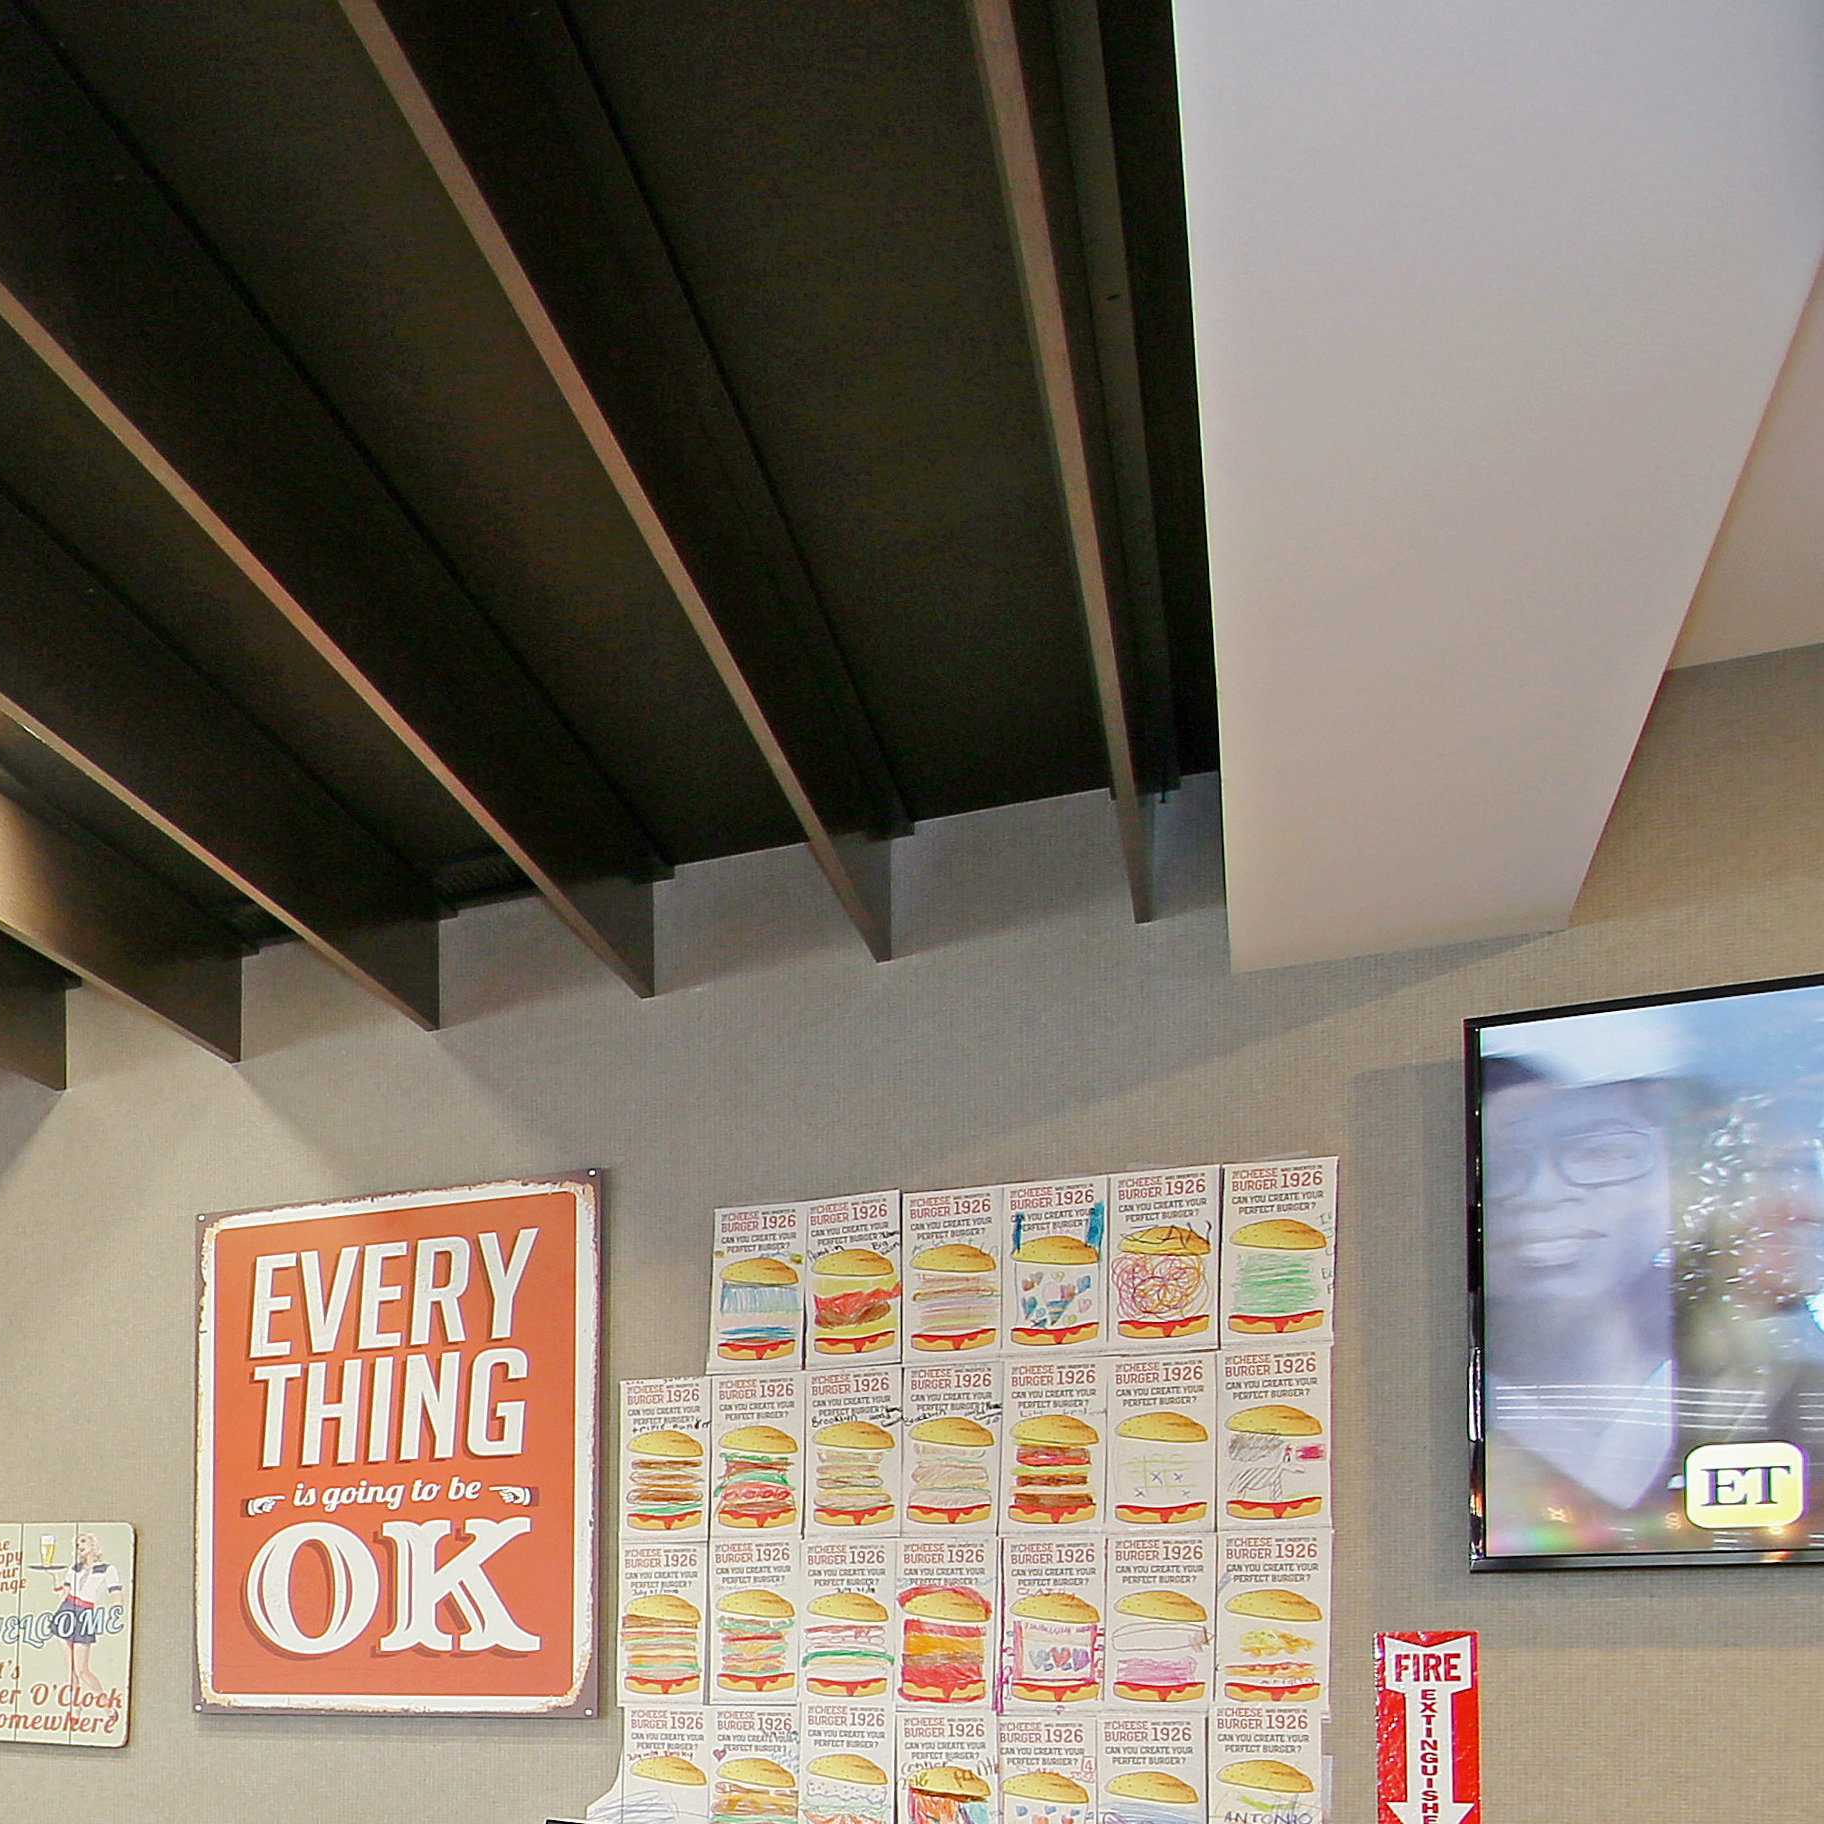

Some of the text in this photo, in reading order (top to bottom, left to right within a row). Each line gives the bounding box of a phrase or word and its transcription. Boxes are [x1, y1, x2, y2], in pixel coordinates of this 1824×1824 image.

[1232, 1171, 1323, 1192] BURGER 1926
[1241, 1166, 1278, 1179] CHEESE
[1118, 1179, 1206, 1200] BURGER 1926
[810, 1204, 888, 1226] BURGER 1926
[910, 1198, 991, 1219] BURGER 1926
[721, 1214, 796, 1233] BURGER 1926
[249, 1227, 540, 1359] EVERY
[1225, 1357, 1316, 1377] BURGER 1926
[1234, 1353, 1271, 1365] CHEESE
[1011, 1370, 1096, 1386] BURGER 1926
[1116, 1366, 1203, 1385] BURGER 1926
[627, 1389, 700, 1405] BURGER 1926
[254, 1347, 529, 1468] THING
[294, 1477, 480, 1511] is going to be
[1701, 1466, 1791, 1506] ET
[1124, 1538, 1160, 1549] CHEESE
[1226, 1544, 1318, 1560] BURGER 1926
[1235, 1538, 1272, 1549] CHEESE
[715, 1547, 790, 1563] BURGER 1926
[904, 1549, 984, 1563] BURGER 1926
[1115, 1546, 1203, 1561] BURGER 1926
[247, 1517, 540, 1655] OK
[1395, 1653, 1462, 1682] FIRE
[30, 1683, 122, 1709] O'Clock
[1226, 1706, 1264, 1717] CHEESE
[1217, 1714, 1308, 1730] BURGER 1926
[1104, 1727, 1192, 1743] BURGER 1926
